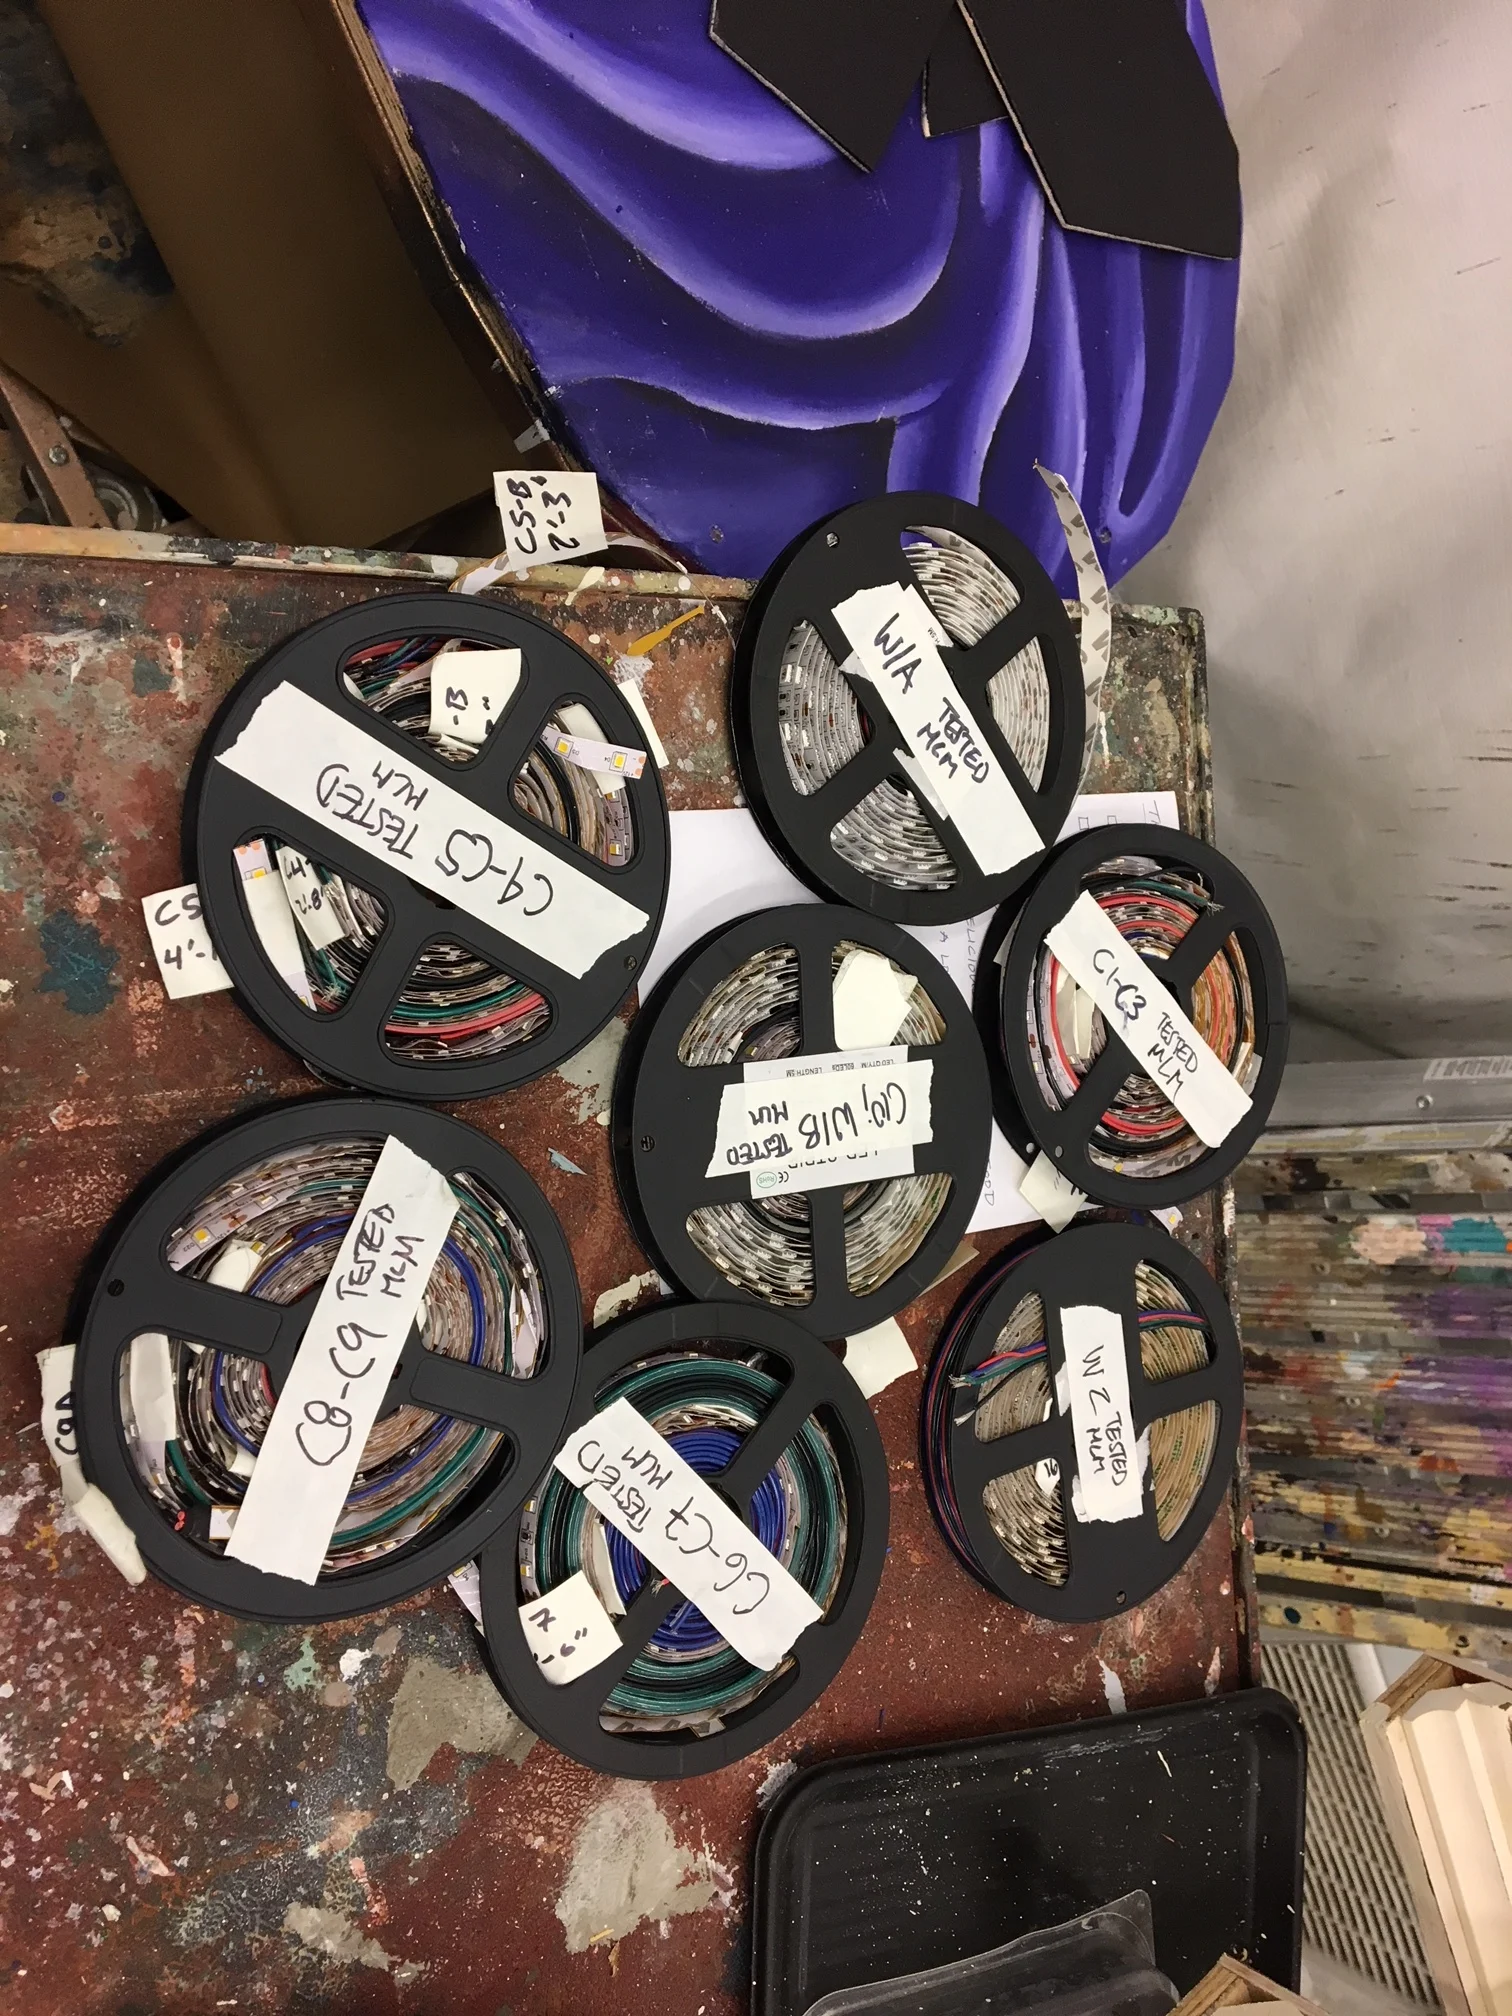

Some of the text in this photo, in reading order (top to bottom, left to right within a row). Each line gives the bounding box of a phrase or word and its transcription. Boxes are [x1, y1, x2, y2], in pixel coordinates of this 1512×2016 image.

[506, 477, 537, 555] C5-B
[873, 612, 922, 694] W/A
[935, 696, 990, 784] TESTED
[316, 763, 418, 860] TESTED
[435, 828, 555, 917] C4-C5
[1093, 948, 1147, 1020] C1-C3
[796, 1066, 823, 1076] LENGTH
[1155, 1011, 1199, 1074] TESTED
[727, 1132, 793, 1167] TESTED
[758, 1175, 775, 1184] RoHS
[336, 1203, 396, 1300] TESTED
[296, 1322, 388, 1466] C8-C9
[577, 1440, 652, 1533] TESTED
[1105, 1411, 1128, 1487] TESTED
[665, 1496, 770, 1615] C6-C7
